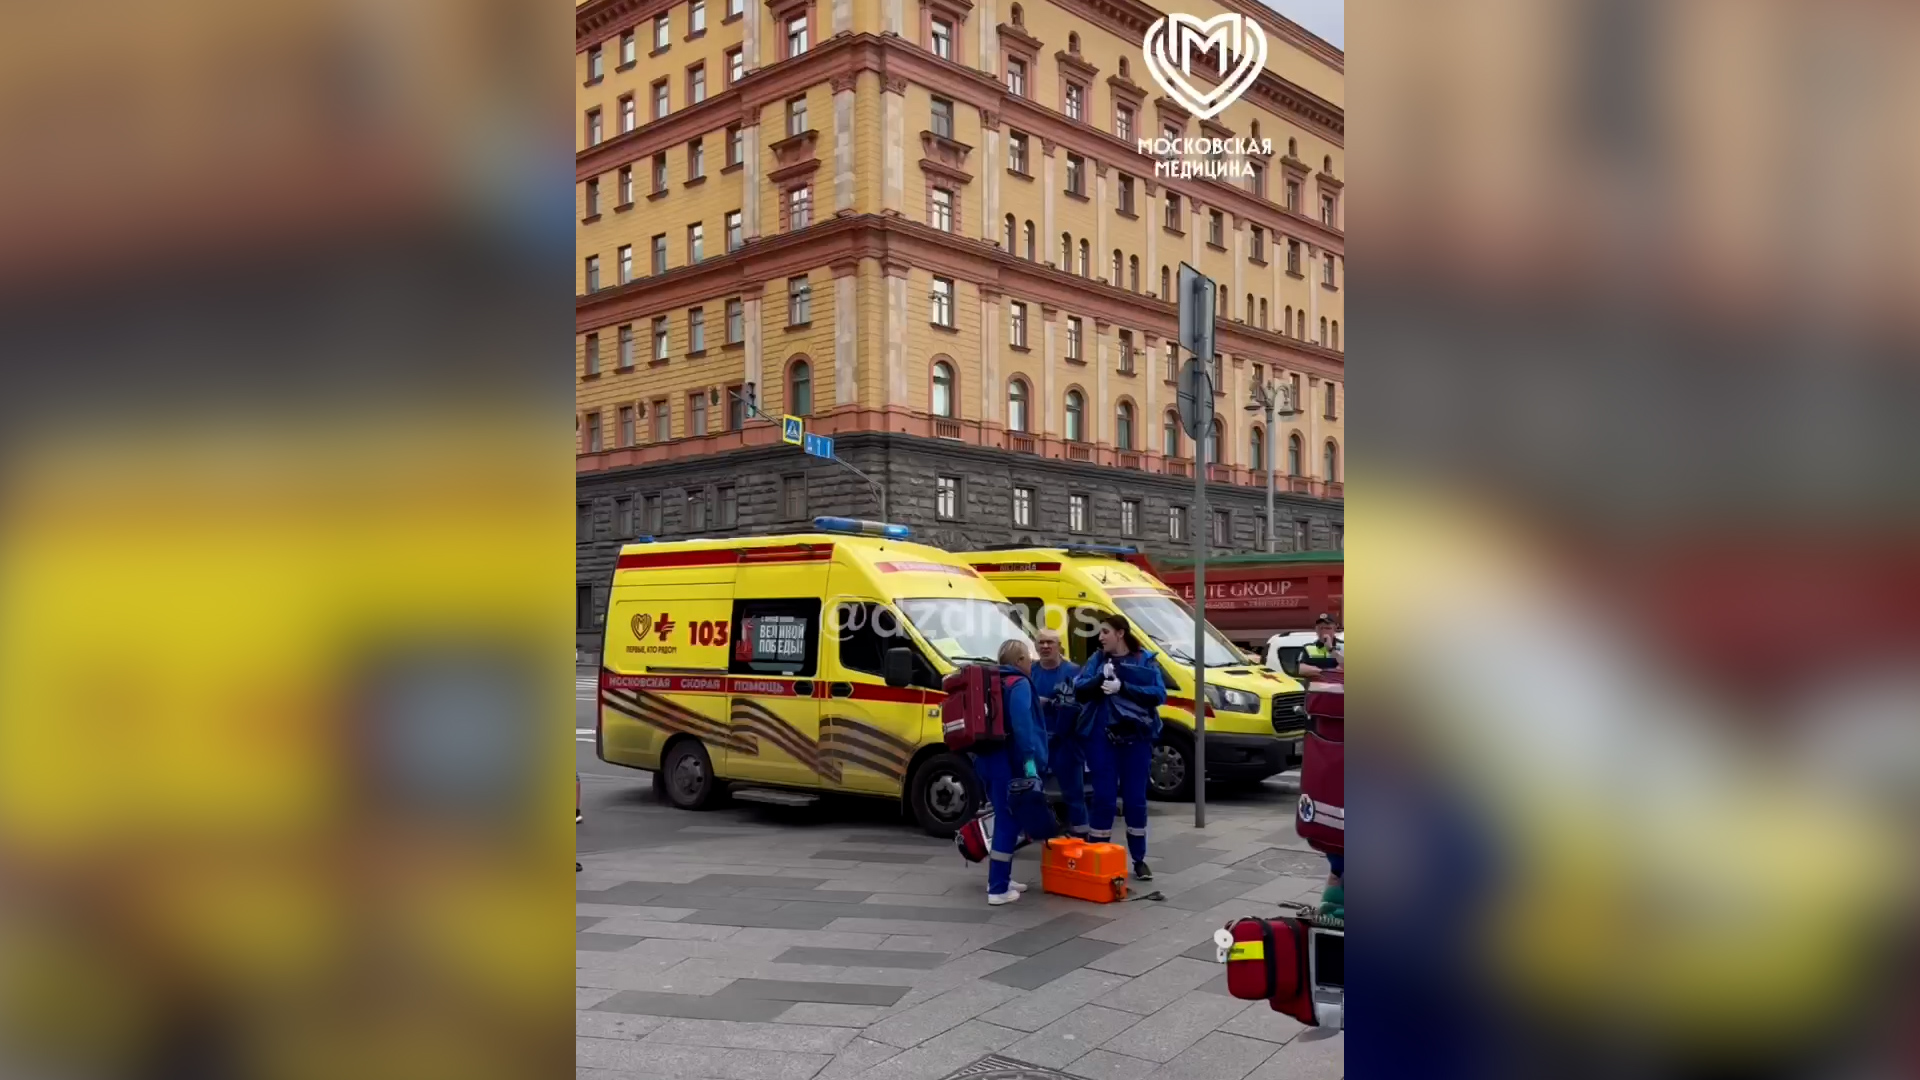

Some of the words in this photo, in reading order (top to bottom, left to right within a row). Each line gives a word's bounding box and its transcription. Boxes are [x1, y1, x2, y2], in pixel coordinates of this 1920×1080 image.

[1230, 580, 1292, 598] GROUP
[688, 620, 729, 647] 103
[759, 623, 805, 639] ВЕЛИКОЙ
[758, 639, 804, 655] ПОБЕДЫ!
[608, 676, 671, 688] МОСКОВСКАЯ
[680, 678, 720, 690] СКОРАЯ
[733, 680, 785, 694] ПОМОЩЬ
